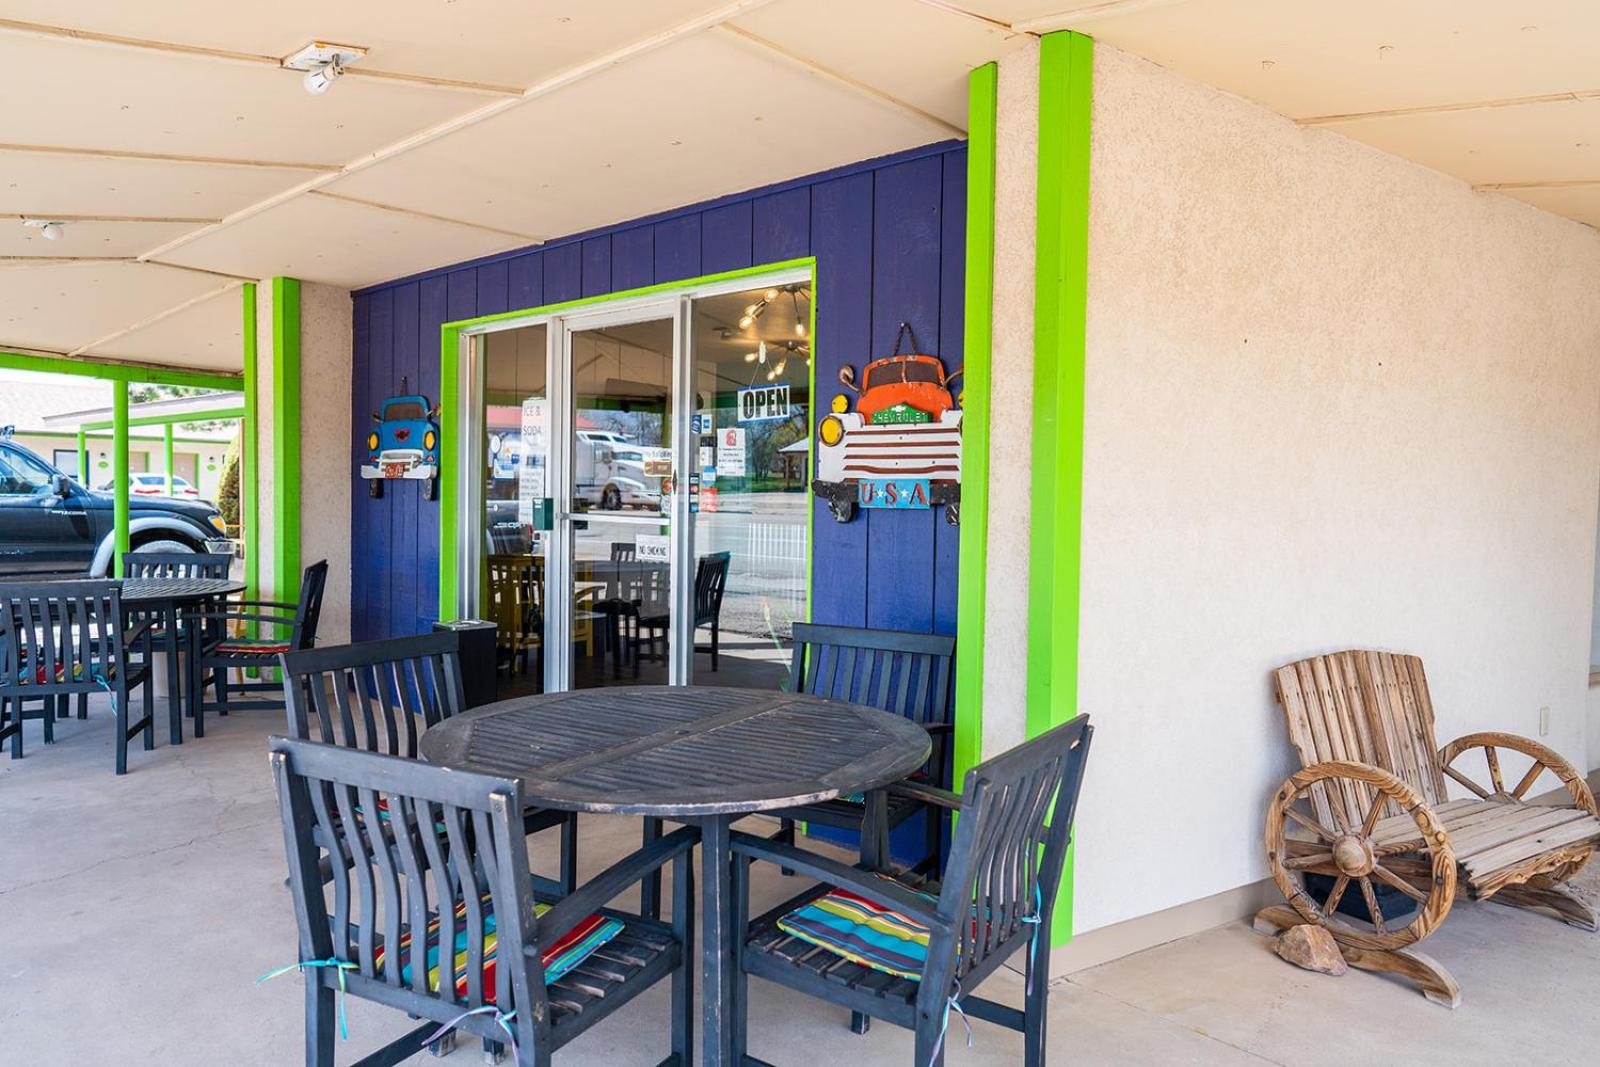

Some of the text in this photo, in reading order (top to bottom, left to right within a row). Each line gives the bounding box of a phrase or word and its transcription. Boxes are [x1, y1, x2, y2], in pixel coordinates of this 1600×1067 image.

[743, 388, 787, 419] OPEN
[524, 406, 534, 417] ICE
[872, 411, 929, 424] CHEVROLET
[523, 425, 542, 436] SODA
